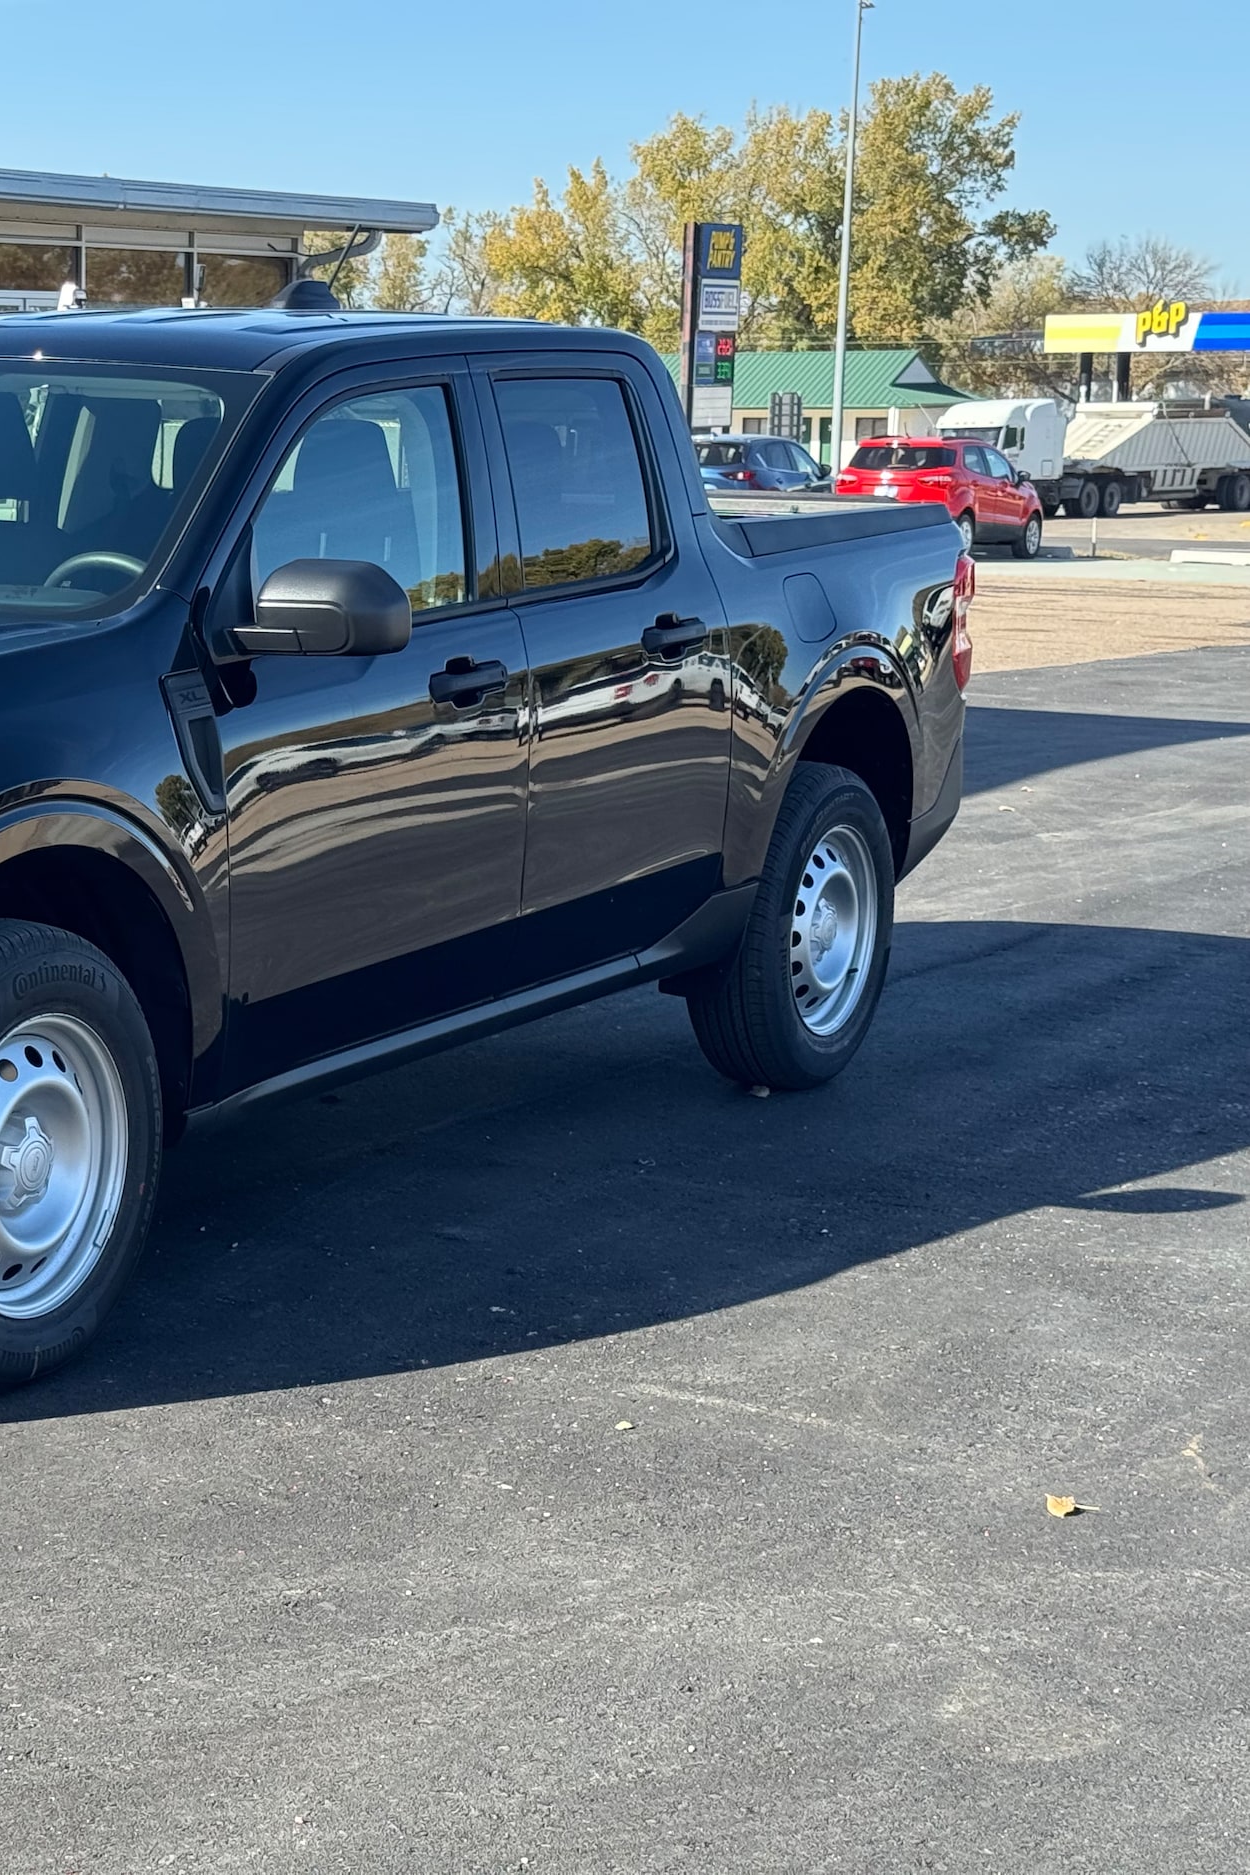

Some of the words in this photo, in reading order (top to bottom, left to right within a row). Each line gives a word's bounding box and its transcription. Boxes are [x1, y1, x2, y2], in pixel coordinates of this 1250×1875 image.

[706, 250, 736, 270] PANTRY
[179, 691, 206, 704] XL
[12, 960, 96, 1000] Continental
